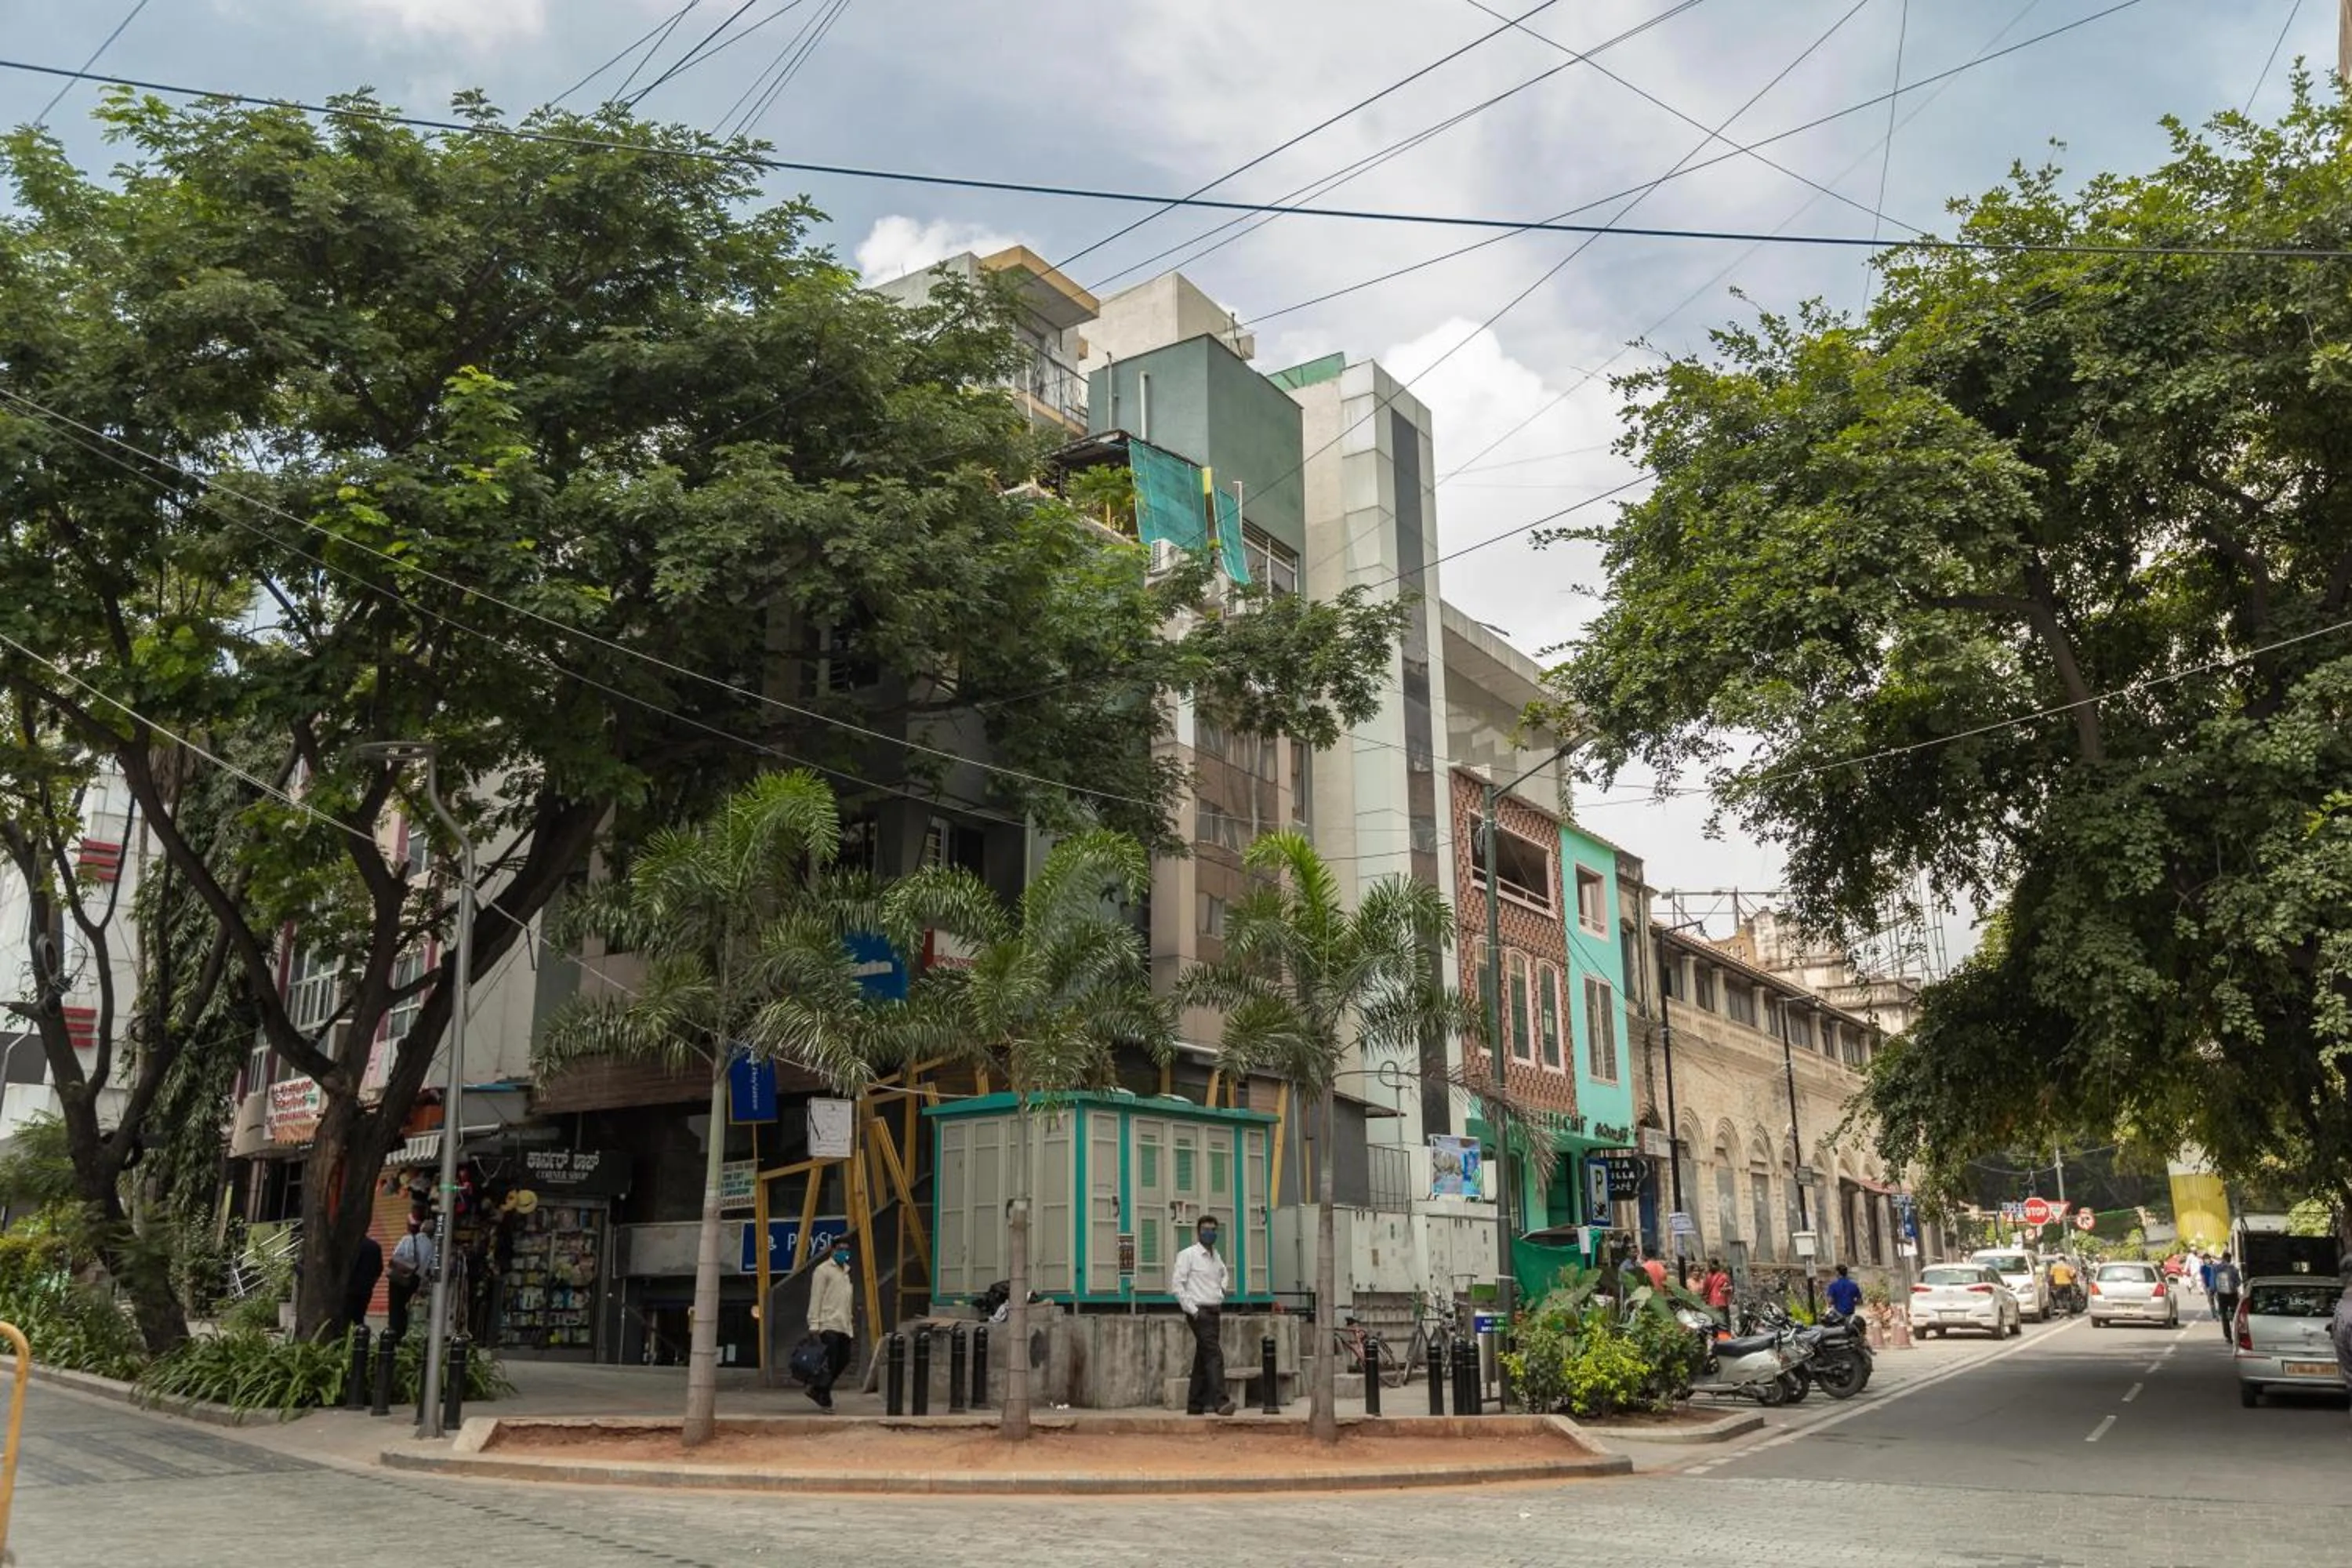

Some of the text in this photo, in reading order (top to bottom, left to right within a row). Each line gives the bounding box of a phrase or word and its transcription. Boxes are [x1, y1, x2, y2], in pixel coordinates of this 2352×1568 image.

[1610, 1171, 1635, 1180] ILLA
[1595, 1169, 1603, 1194] P
[2025, 1207, 2047, 1218] STOP
